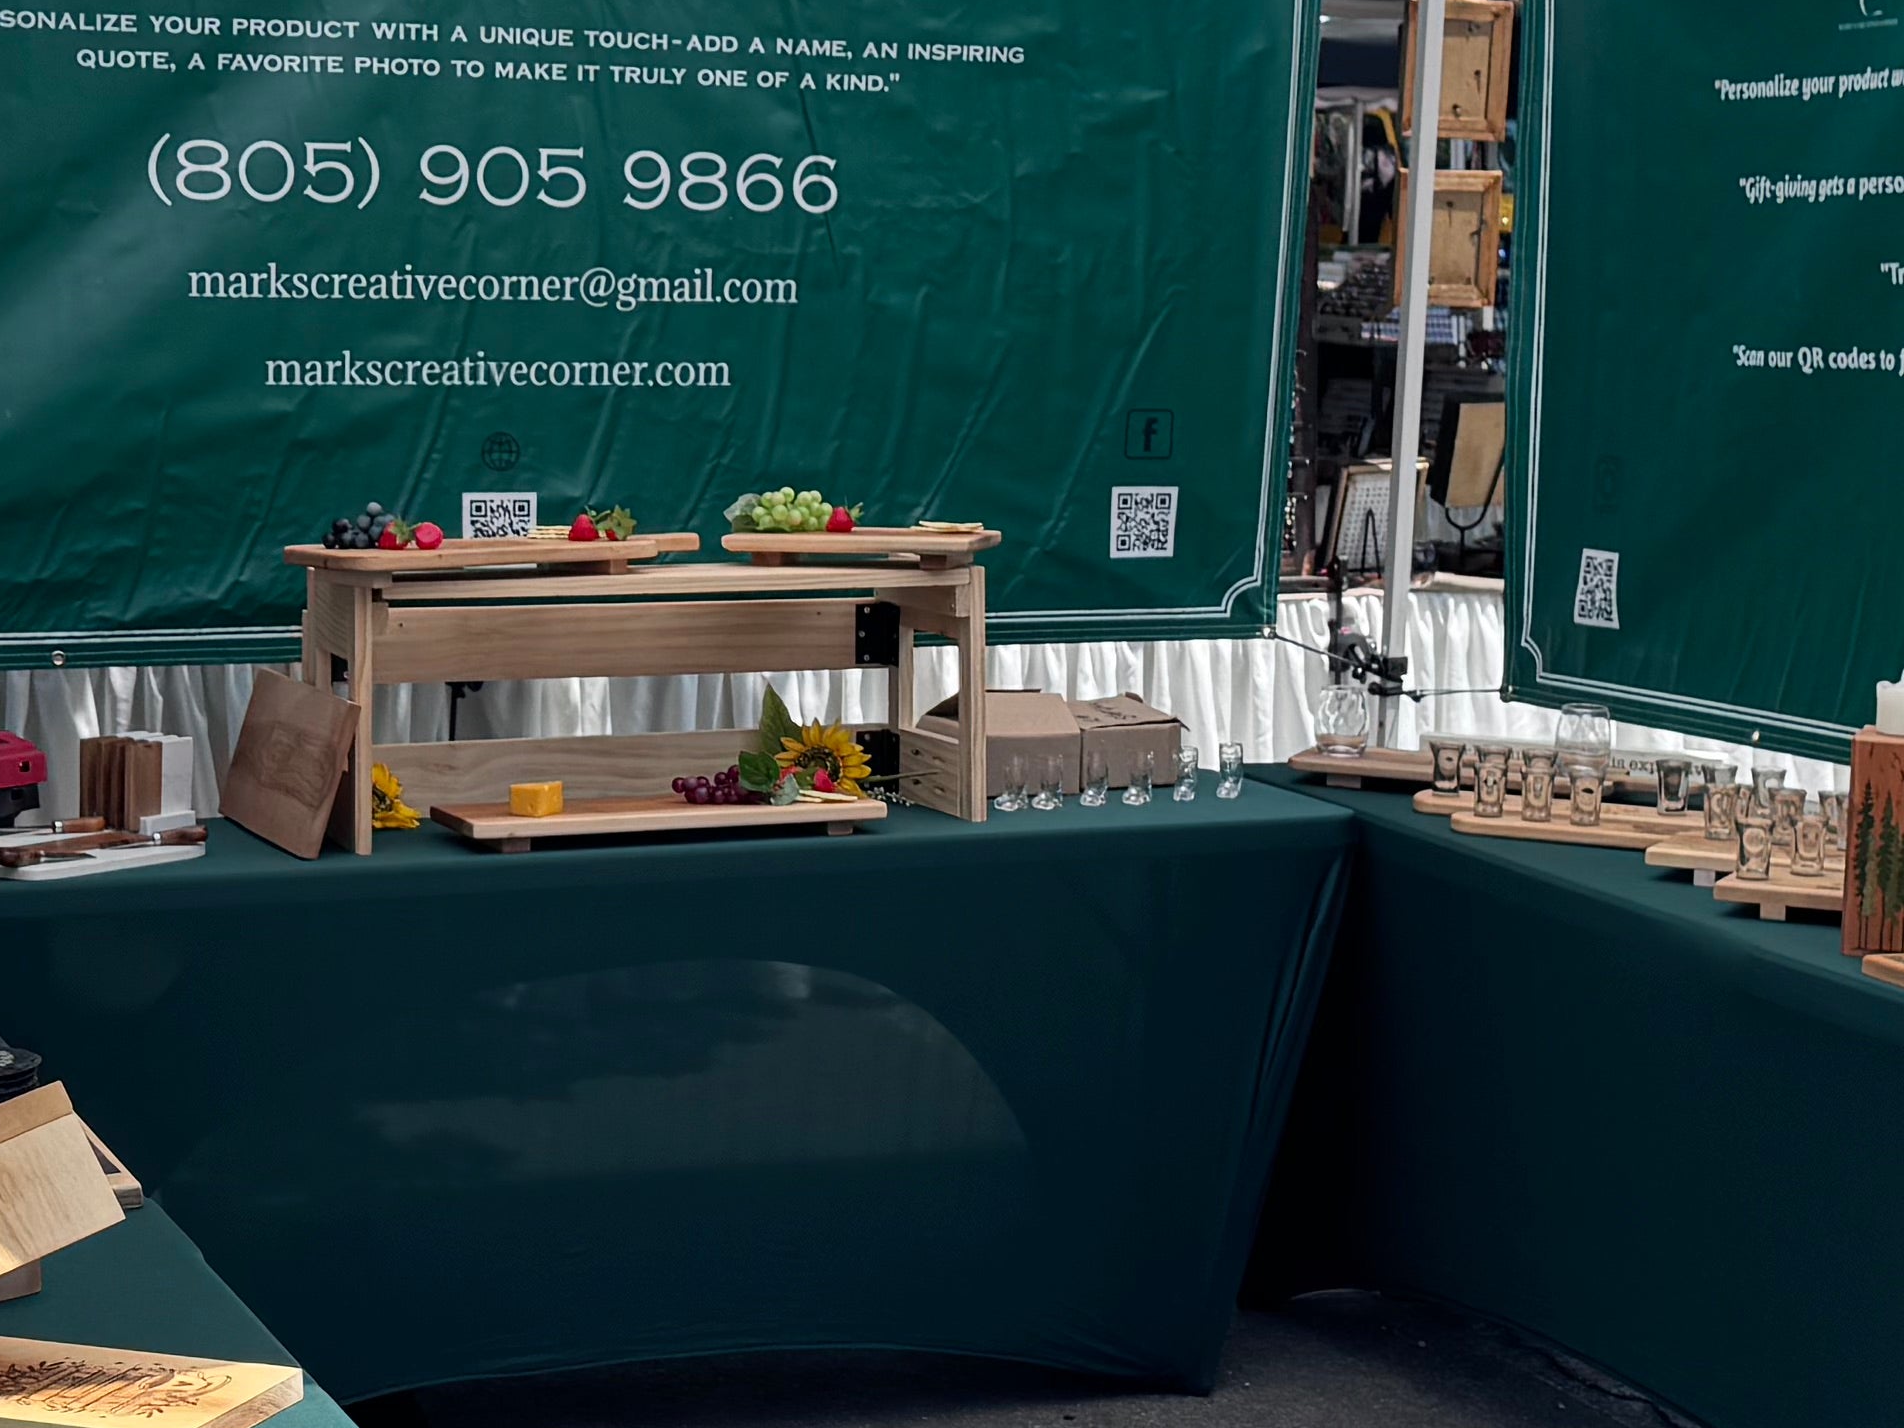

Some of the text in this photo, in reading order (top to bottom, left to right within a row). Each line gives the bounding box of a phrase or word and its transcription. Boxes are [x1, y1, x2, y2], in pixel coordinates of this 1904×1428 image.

[148, 15, 221, 36] YOUR
[232, 18, 361, 39] PRODUCT
[371, 21, 439, 42] WITH
[450, 25, 468, 43] A
[479, 25, 574, 48] UNIQUE
[583, 29, 739, 53] TOUCH-ADD
[748, 36, 766, 54] A
[776, 37, 853, 61] NAME,
[862, 41, 898, 60] AN
[907, 42, 1025, 64] INSPIRING
[76, 48, 177, 73] QUOTE,
[187, 52, 206, 71] A
[217, 53, 345, 74] FAVORITE
[354, 56, 441, 77] PHOTO
[450, 59, 485, 78] TO
[494, 61, 568, 81] MAKE
[577, 64, 601, 82] IT
[608, 65, 687, 85] TRULY
[697, 68, 748, 87] ONE
[756, 70, 790, 89] OF
[799, 72, 817, 90] A
[147, 132, 838, 214] (805) 905 9866
[1818, 175, 1845, 203] gets
[1846, 177, 1856, 195] a
[187, 262, 798, 312] markscreativecorner@gmail.com
[264, 349, 732, 387] markscreativecorner.com
[1767, 350, 1794, 368] our
[1797, 346, 1825, 375] QR
[1828, 346, 1877, 370] codes
[1879, 349, 1896, 371] to
